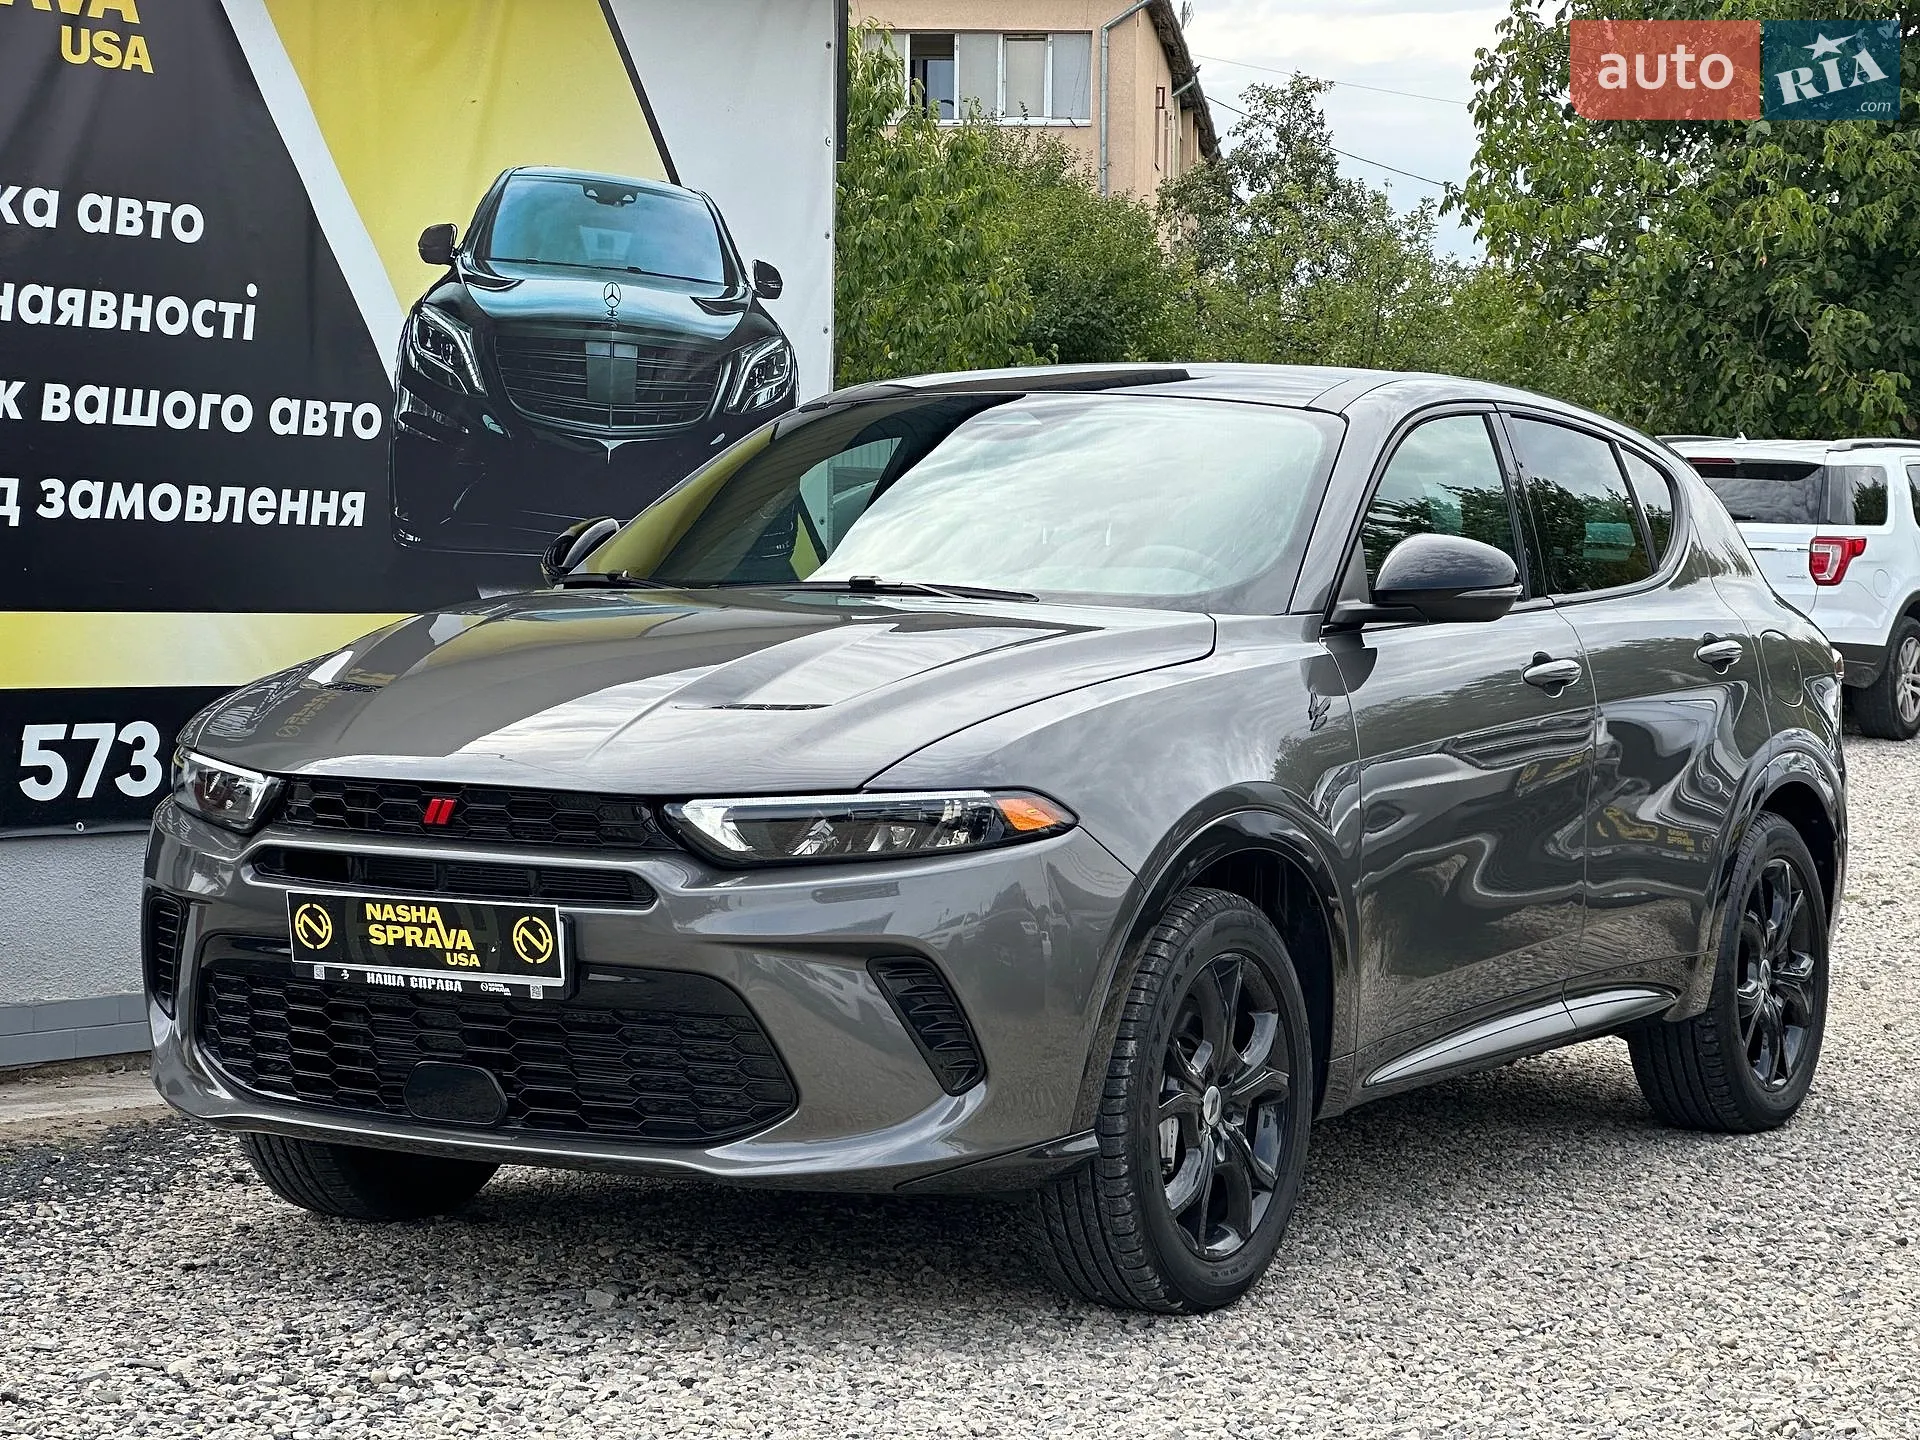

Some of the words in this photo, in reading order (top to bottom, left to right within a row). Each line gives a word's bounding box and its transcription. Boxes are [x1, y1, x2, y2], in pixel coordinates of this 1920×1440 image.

[61, 26, 154, 73] USA
[78, 193, 204, 243] авто
[41, 383, 253, 433] вашого
[270, 397, 382, 440] авто
[36, 478, 366, 527] замовлення
[19, 721, 163, 801] 573
[366, 903, 443, 924] NASHA
[369, 924, 474, 951] SPRAVA
[446, 953, 480, 967] USA
[366, 972, 405, 987] НАША
[410, 976, 463, 992] СПРАВА
